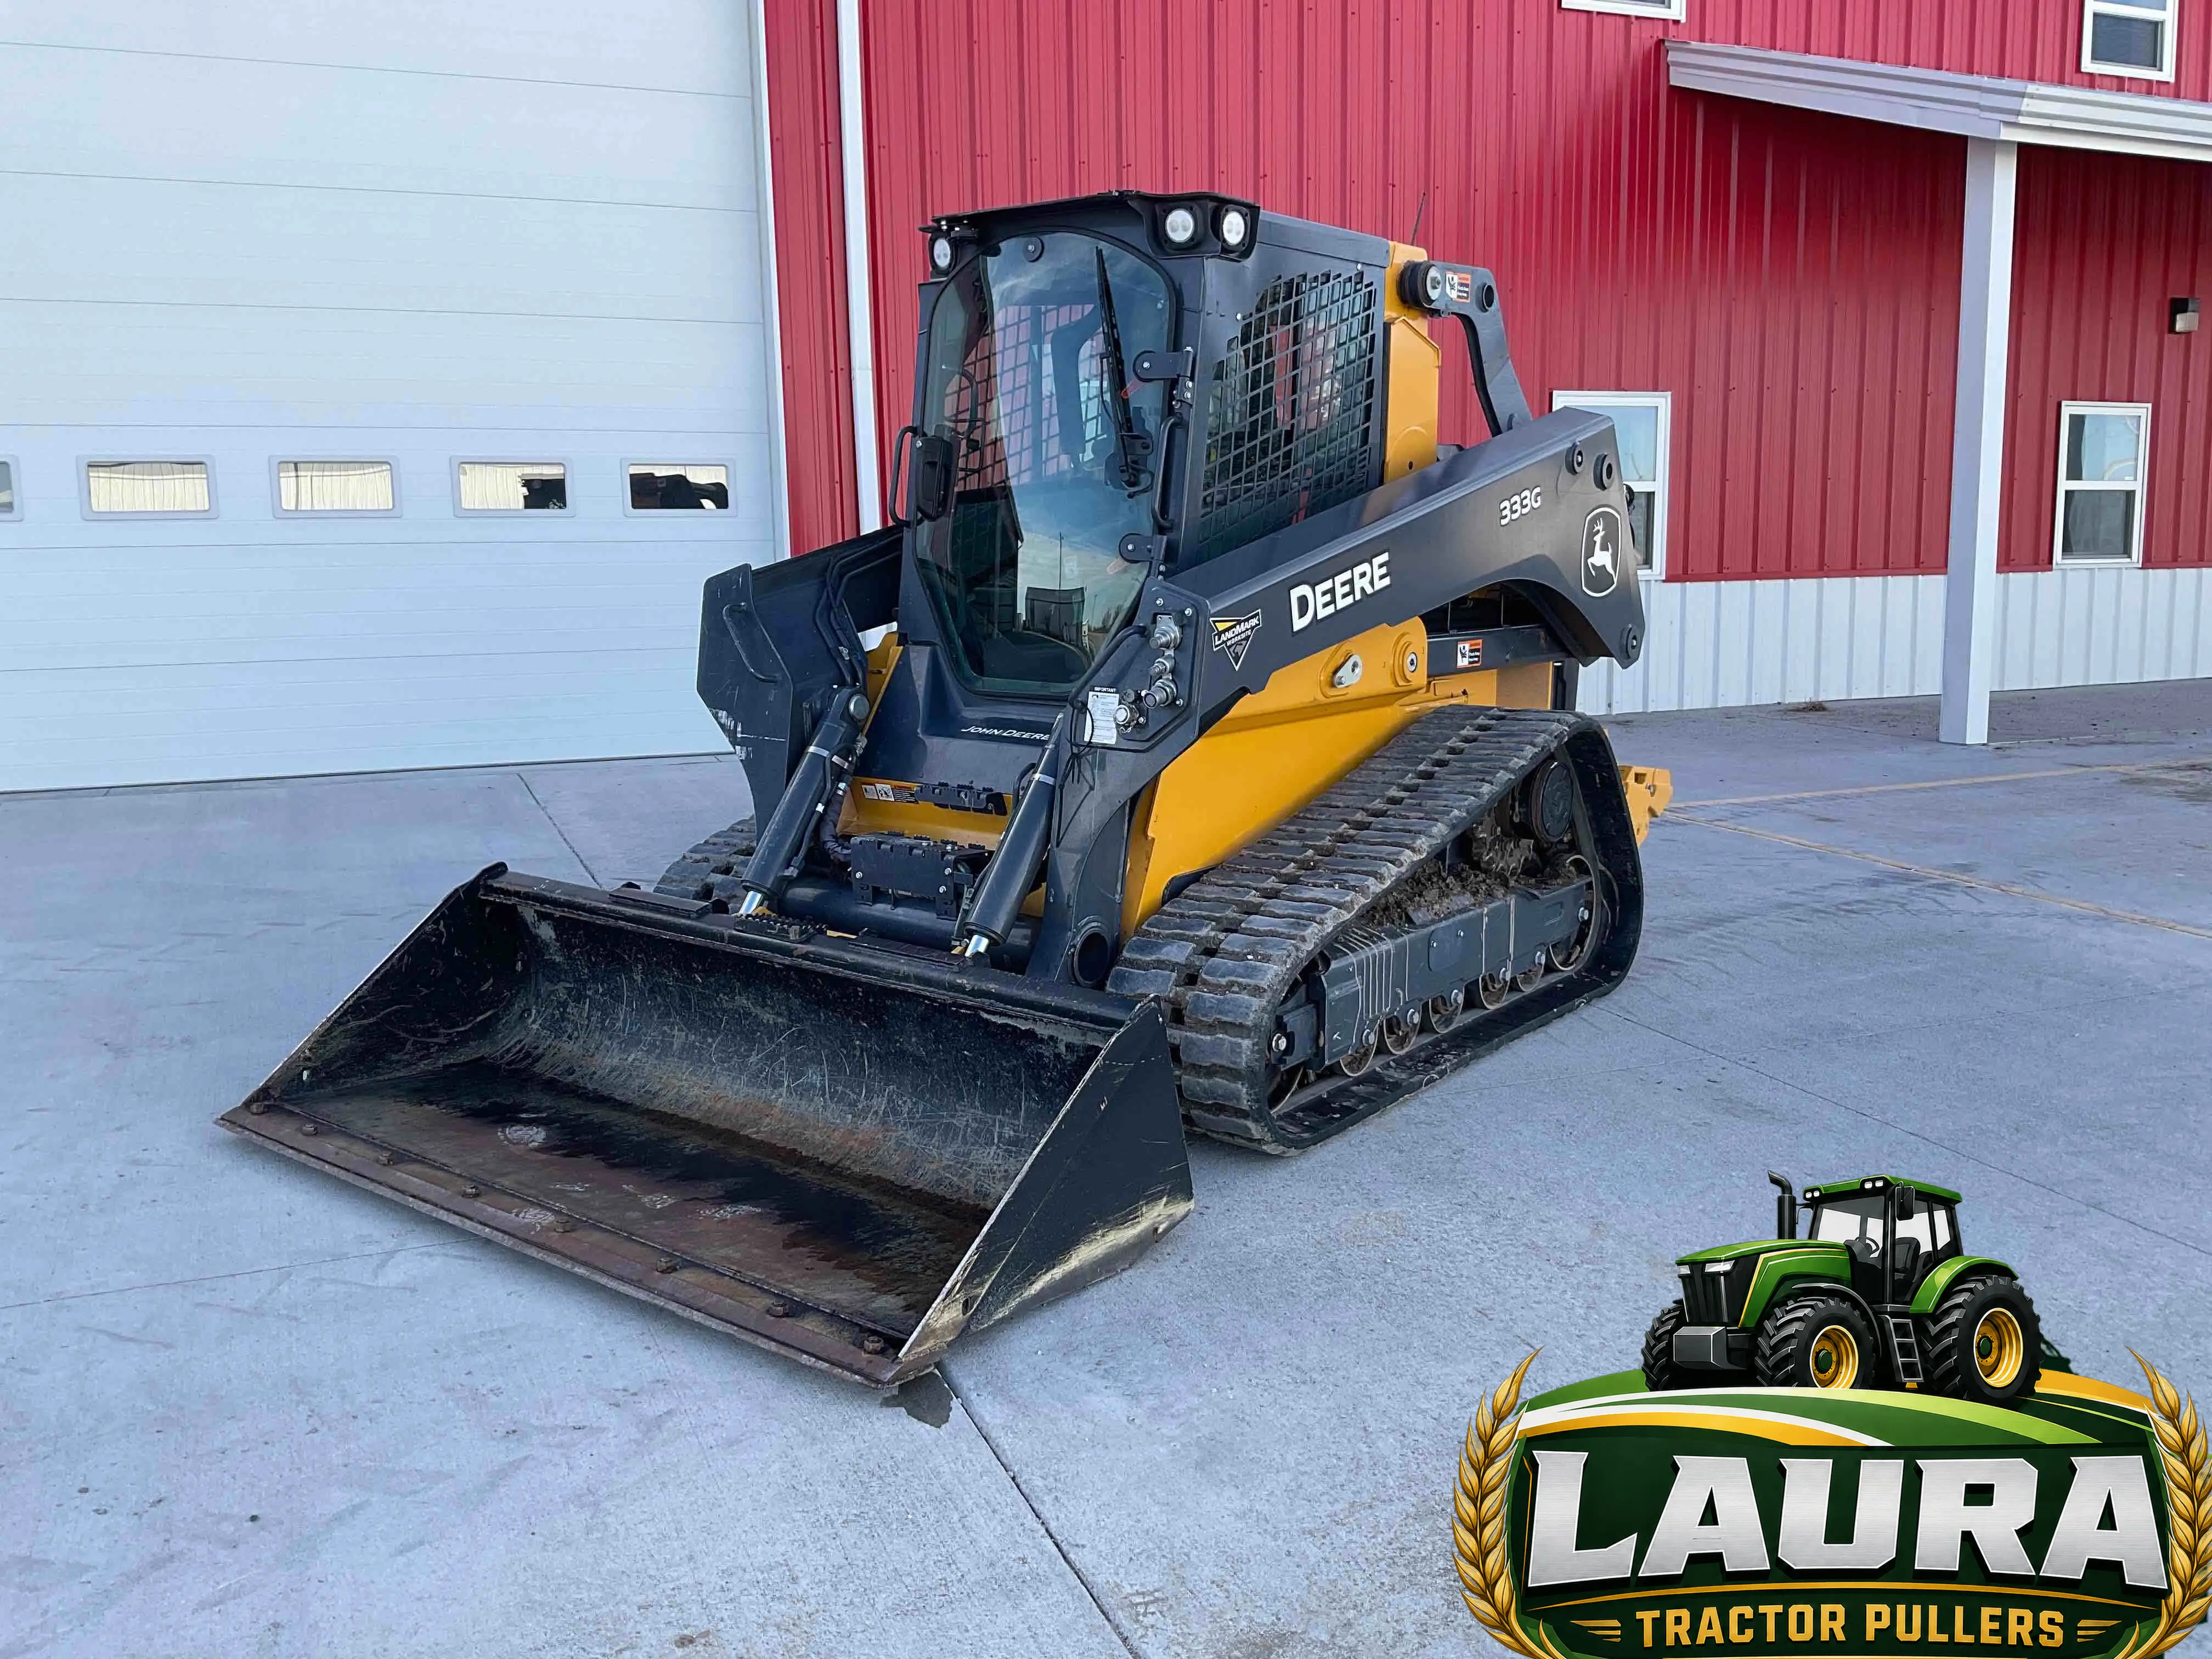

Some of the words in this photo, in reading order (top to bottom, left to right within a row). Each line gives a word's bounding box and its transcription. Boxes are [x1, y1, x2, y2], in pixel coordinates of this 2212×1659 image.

[1500, 487, 1541, 525] 333G
[1290, 552, 1391, 632] DEERE
[1215, 616, 1259, 645] LANDMARK
[1226, 629, 1251, 646] WORKSITE
[961, 726, 1002, 735] JOHN
[1002, 729, 1050, 740] DEERE
